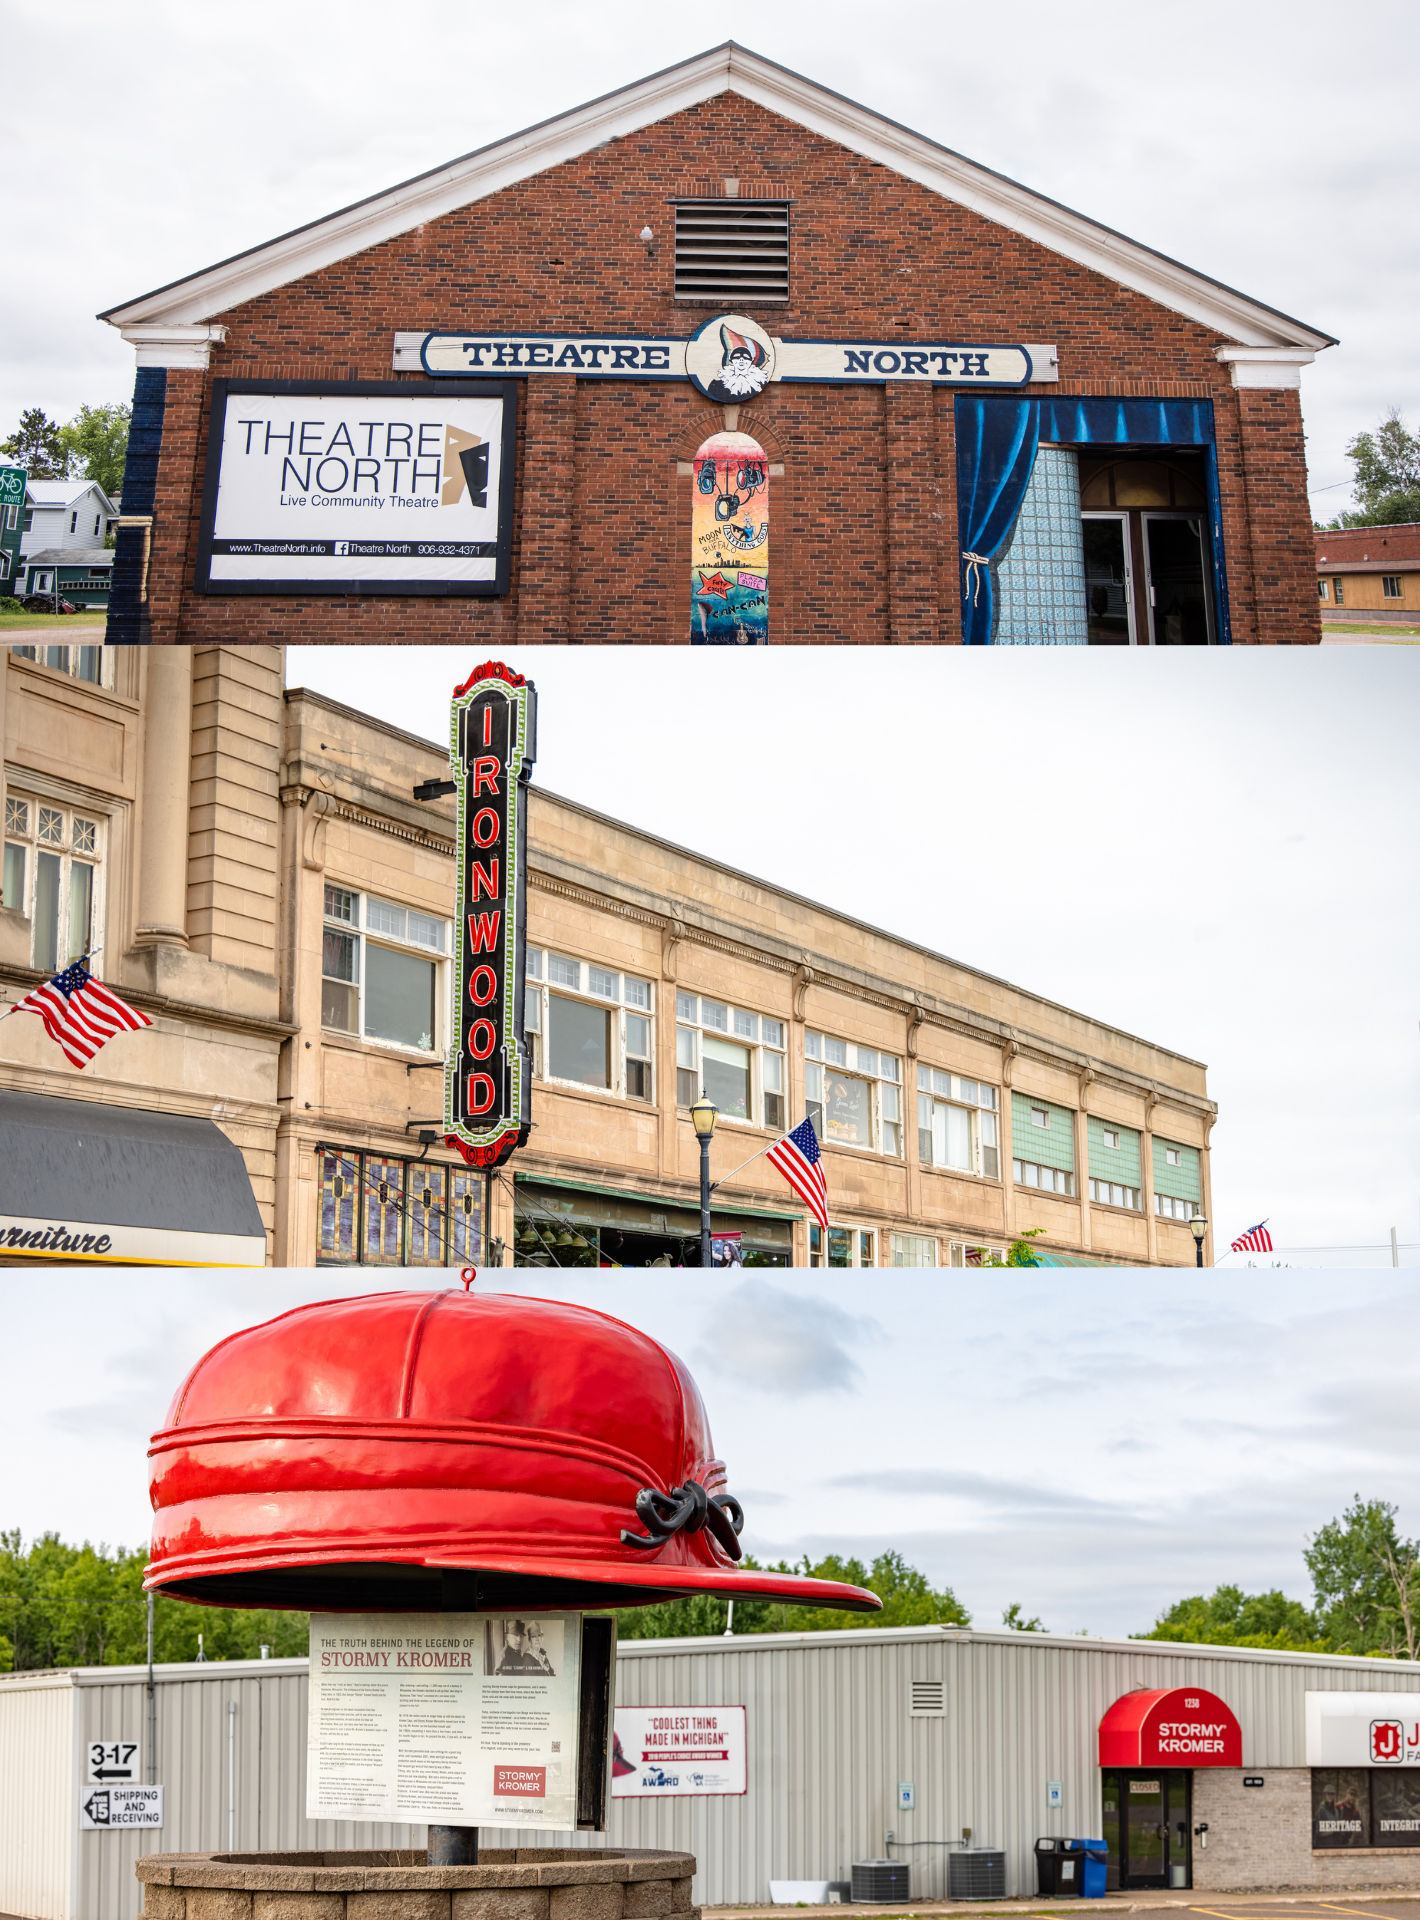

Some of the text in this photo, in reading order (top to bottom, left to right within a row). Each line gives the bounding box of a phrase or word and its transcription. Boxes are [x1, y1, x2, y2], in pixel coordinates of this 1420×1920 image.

[462, 342, 990, 376] THEATRE NORTH
[238, 420, 443, 457] THEATRE
[281, 457, 441, 493] NORTH
[4, 494, 21, 504] ROUTE
[281, 495, 439, 510] Live Community Theatre
[699, 527, 722, 545] MOON
[726, 530, 756, 548] ANYTHING
[229, 543, 326, 554] www.TheatreNorth.info
[350, 543, 384, 554] Theatre
[386, 543, 411, 554] North
[418, 544, 480, 555] 906-932-4371
[702, 541, 737, 555] BUFFALO
[740, 574, 764, 584] PLAZA
[741, 580, 761, 589] SUITE
[467, 703, 501, 1116] IRONWOOD
[321, 1638, 475, 1648] THE TRUTH BEHIND THE LEGEND OF
[321, 1651, 473, 1668] STORMY KROMER
[692, 1717, 718, 1730] THING
[1158, 1722, 1223, 1737] STORMY
[645, 1733, 669, 1746] MADE
[671, 1733, 681, 1746] IN
[1158, 1739, 1225, 1753] KROMER
[1379, 1729, 1394, 1754] J
[91, 1744, 138, 1766] 3-17
[498, 1771, 541, 1781] STORMY
[498, 1781, 540, 1792] KROMER
[1130, 1783, 1160, 1792] CLOSED
[114, 1791, 158, 1801] SHIPPING
[89, 1803, 109, 1820] 15
[124, 1802, 146, 1812] AND
[111, 1813, 160, 1823] RECEIVING
[1318, 1819, 1362, 1833] HERITAGE
